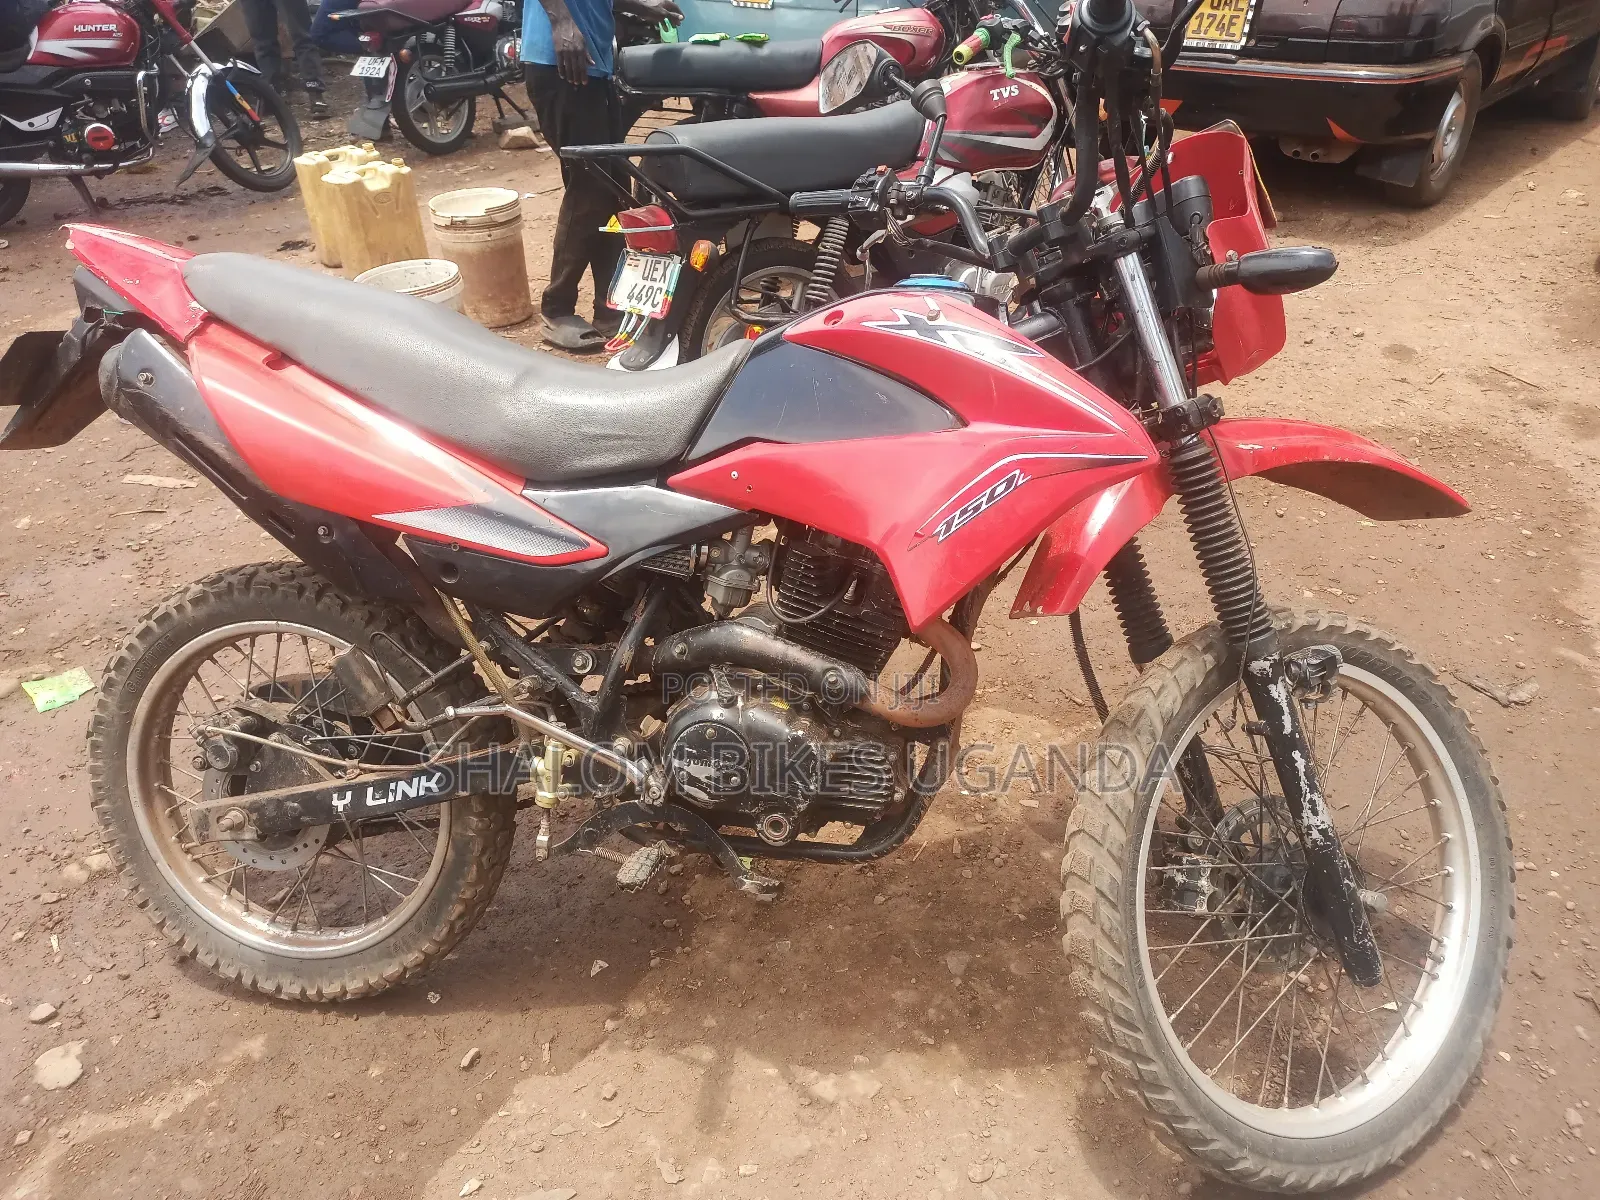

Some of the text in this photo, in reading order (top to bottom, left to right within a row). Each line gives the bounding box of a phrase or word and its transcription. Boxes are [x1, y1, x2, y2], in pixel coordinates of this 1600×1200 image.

[73, 23, 118, 33] HUNTER
[1191, 12, 1241, 38] 174E
[358, 66, 382, 77] 192A
[989, 84, 1020, 101] TVS
[641, 258, 671, 284] UEX
[626, 282, 663, 309] 449C
